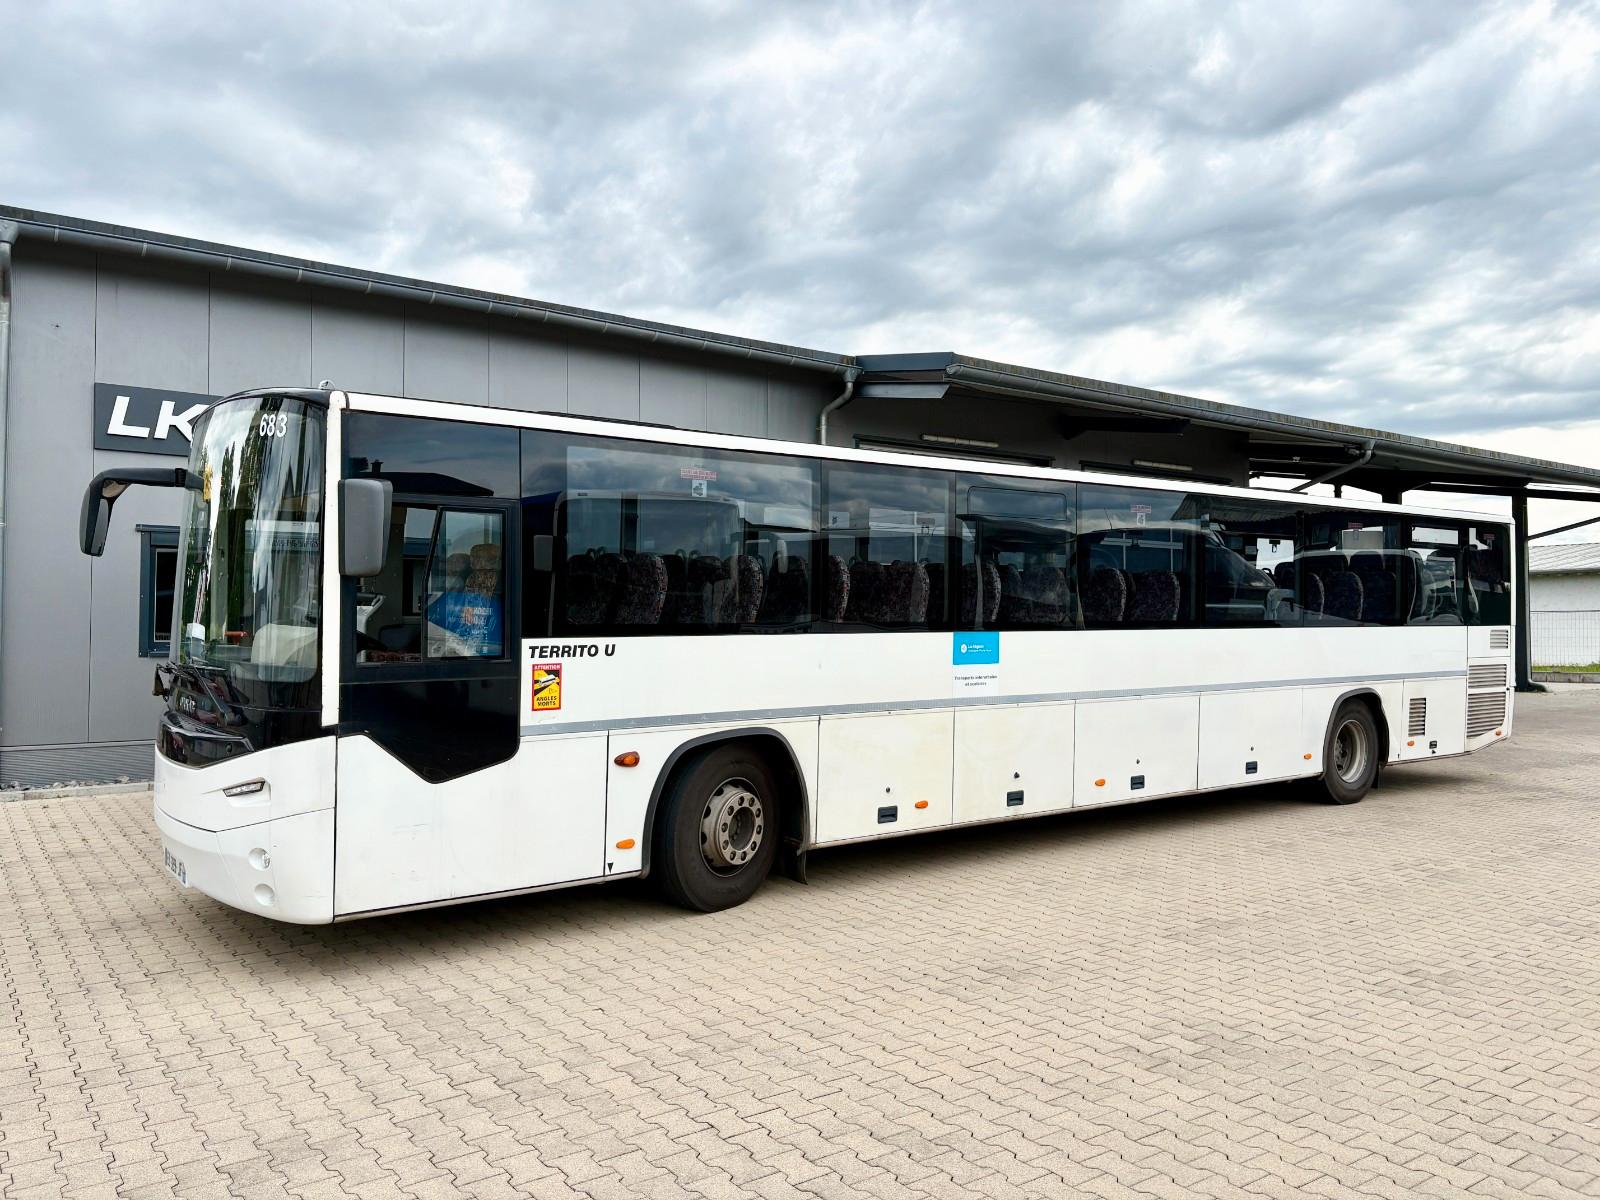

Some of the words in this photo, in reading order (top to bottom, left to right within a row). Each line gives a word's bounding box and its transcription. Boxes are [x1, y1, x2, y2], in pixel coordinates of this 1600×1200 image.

[259, 413, 288, 438] 683
[528, 644, 599, 659] TERRITO
[604, 643, 616, 657] U
